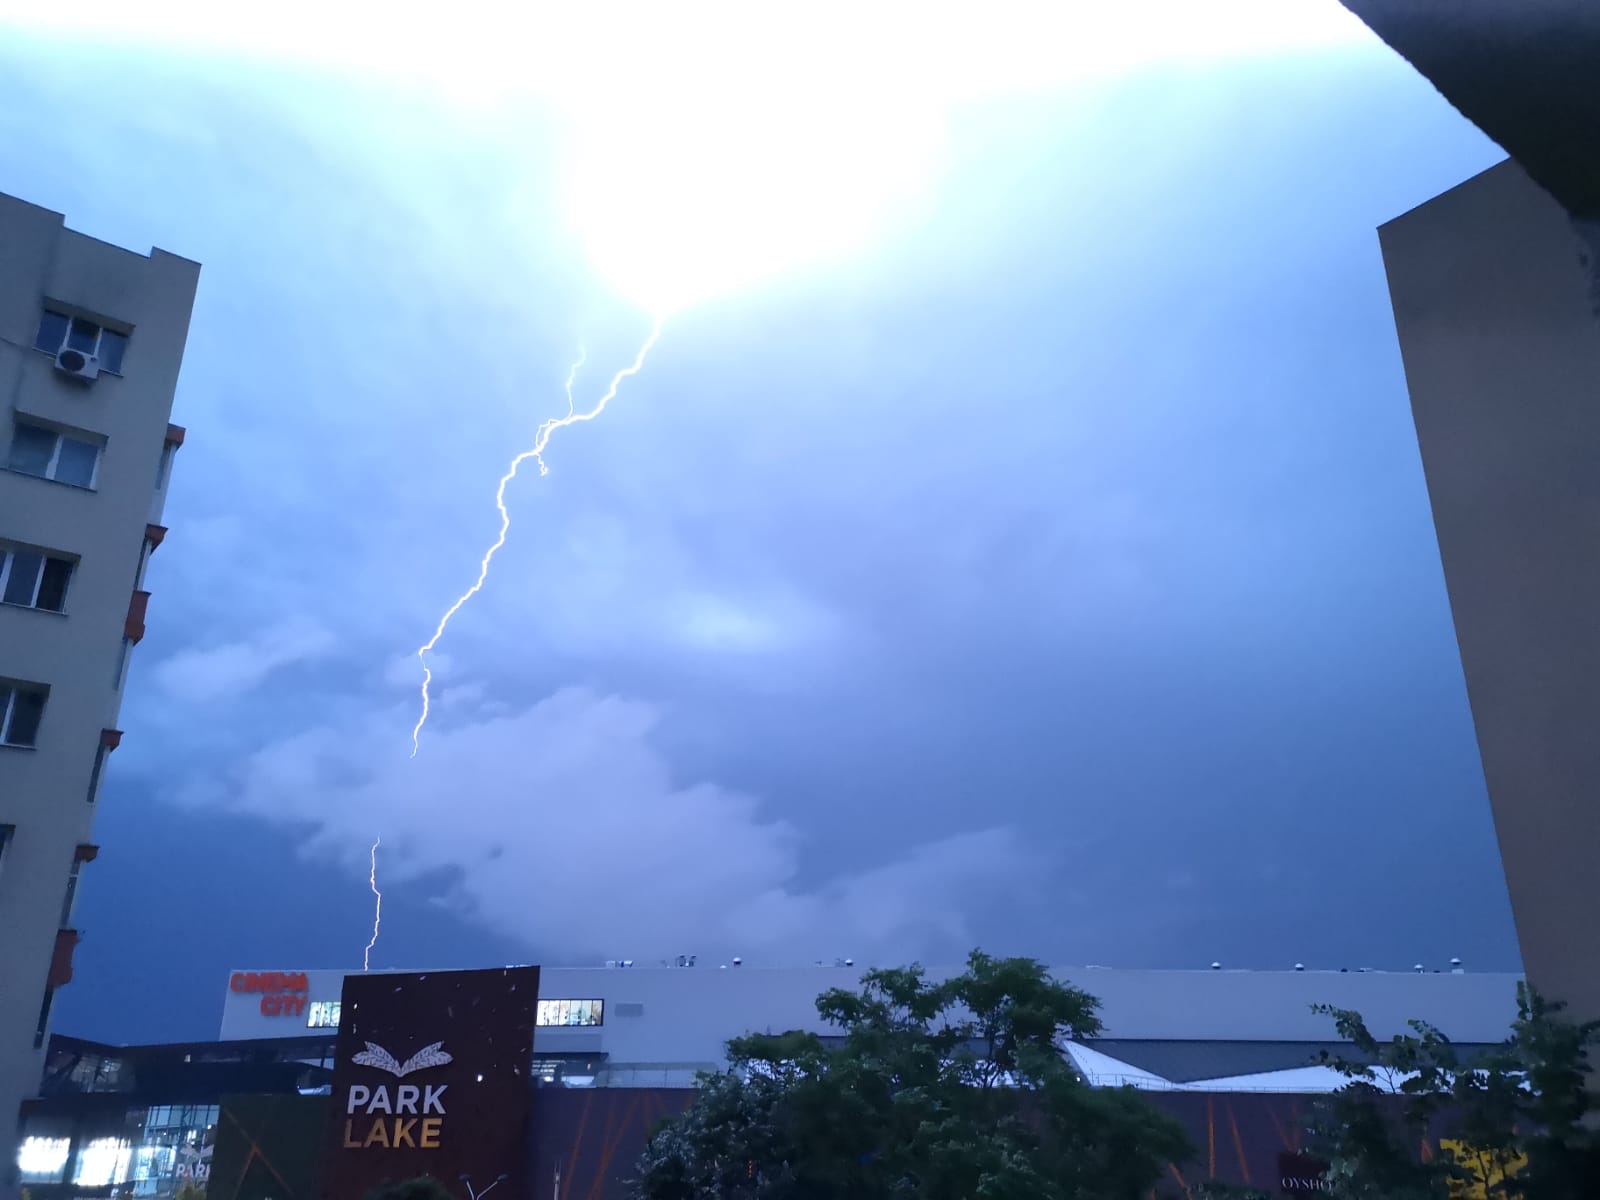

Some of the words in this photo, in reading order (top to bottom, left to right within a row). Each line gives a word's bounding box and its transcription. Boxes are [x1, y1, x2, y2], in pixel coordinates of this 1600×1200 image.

[231, 972, 308, 992] CINEMA
[261, 994, 307, 1016] CITY
[347, 1085, 449, 1114] PARK
[344, 1118, 442, 1148] LAKE
